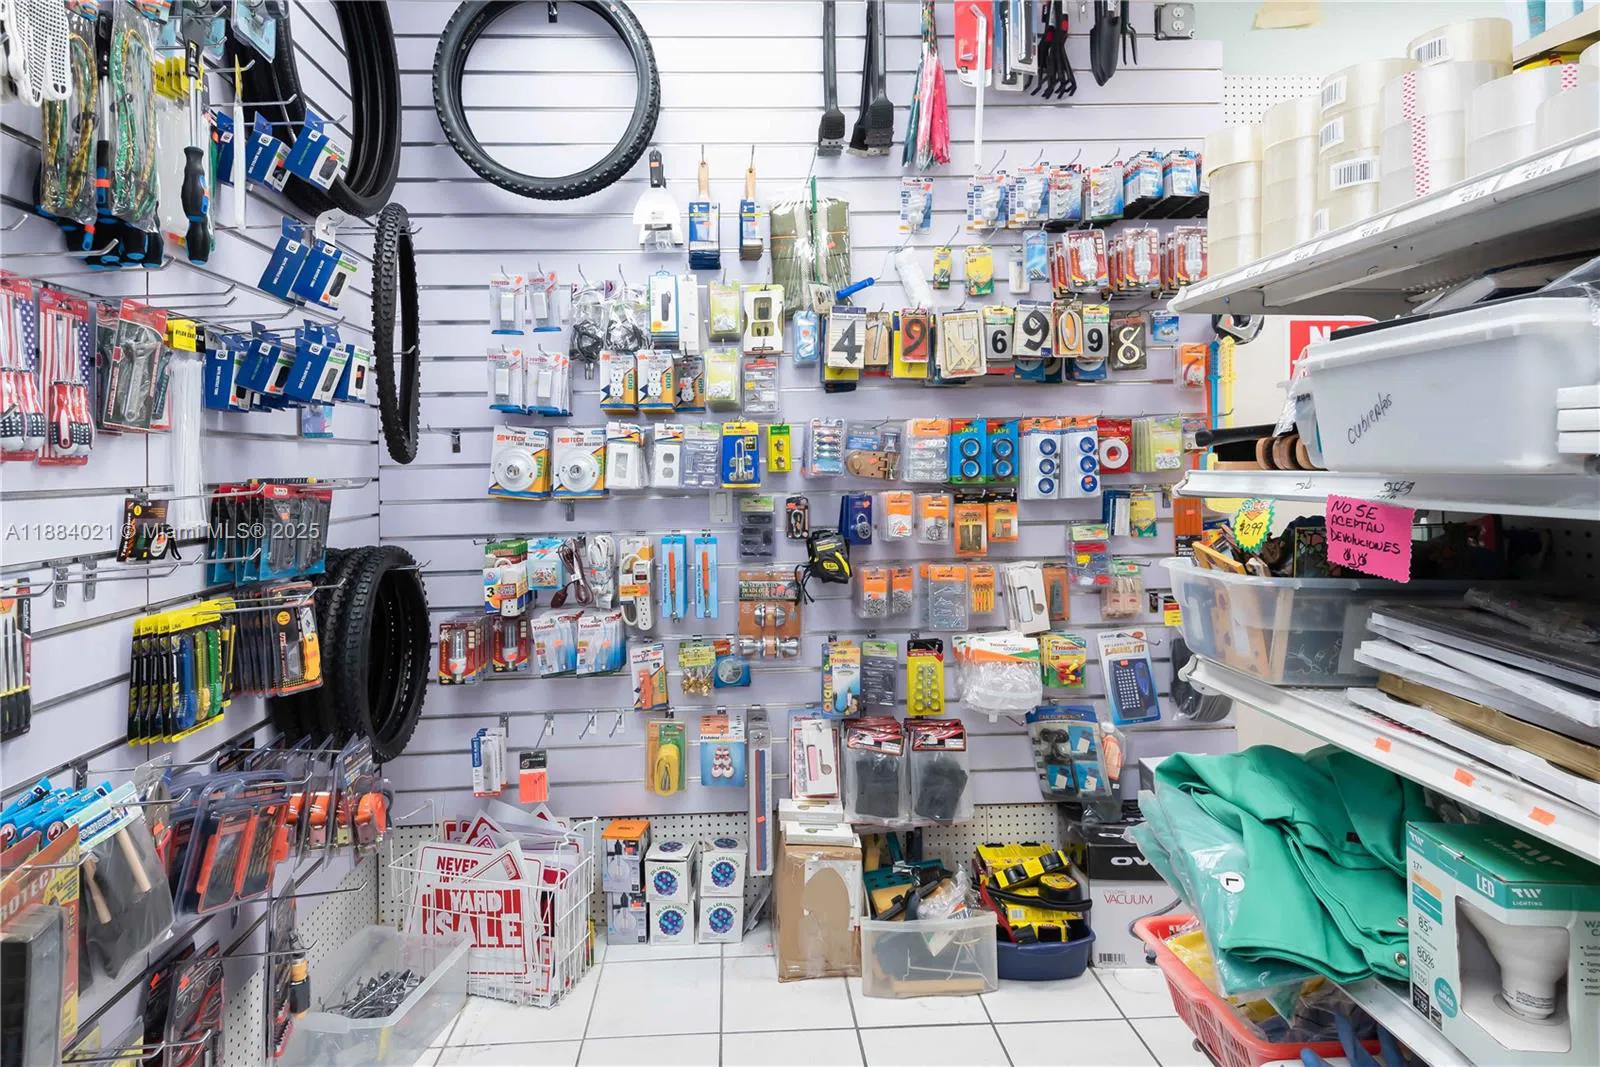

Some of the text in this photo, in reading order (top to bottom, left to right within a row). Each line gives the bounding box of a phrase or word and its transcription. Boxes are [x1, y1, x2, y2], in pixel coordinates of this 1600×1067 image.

[831, 318, 864, 365] 4
[992, 329, 1008, 354] 6
[1087, 328, 1104, 352] 9
[1117, 327, 1141, 365] 8
[1331, 500, 1379, 521] NO SE
[1331, 514, 1385, 534] ACEPTAN
[487, 587, 495, 598] 3
[1476, 873, 1496, 899] LED
[451, 889, 503, 914] YARD
[1104, 894, 1154, 905] VACUUM
[435, 911, 522, 947] SALE
